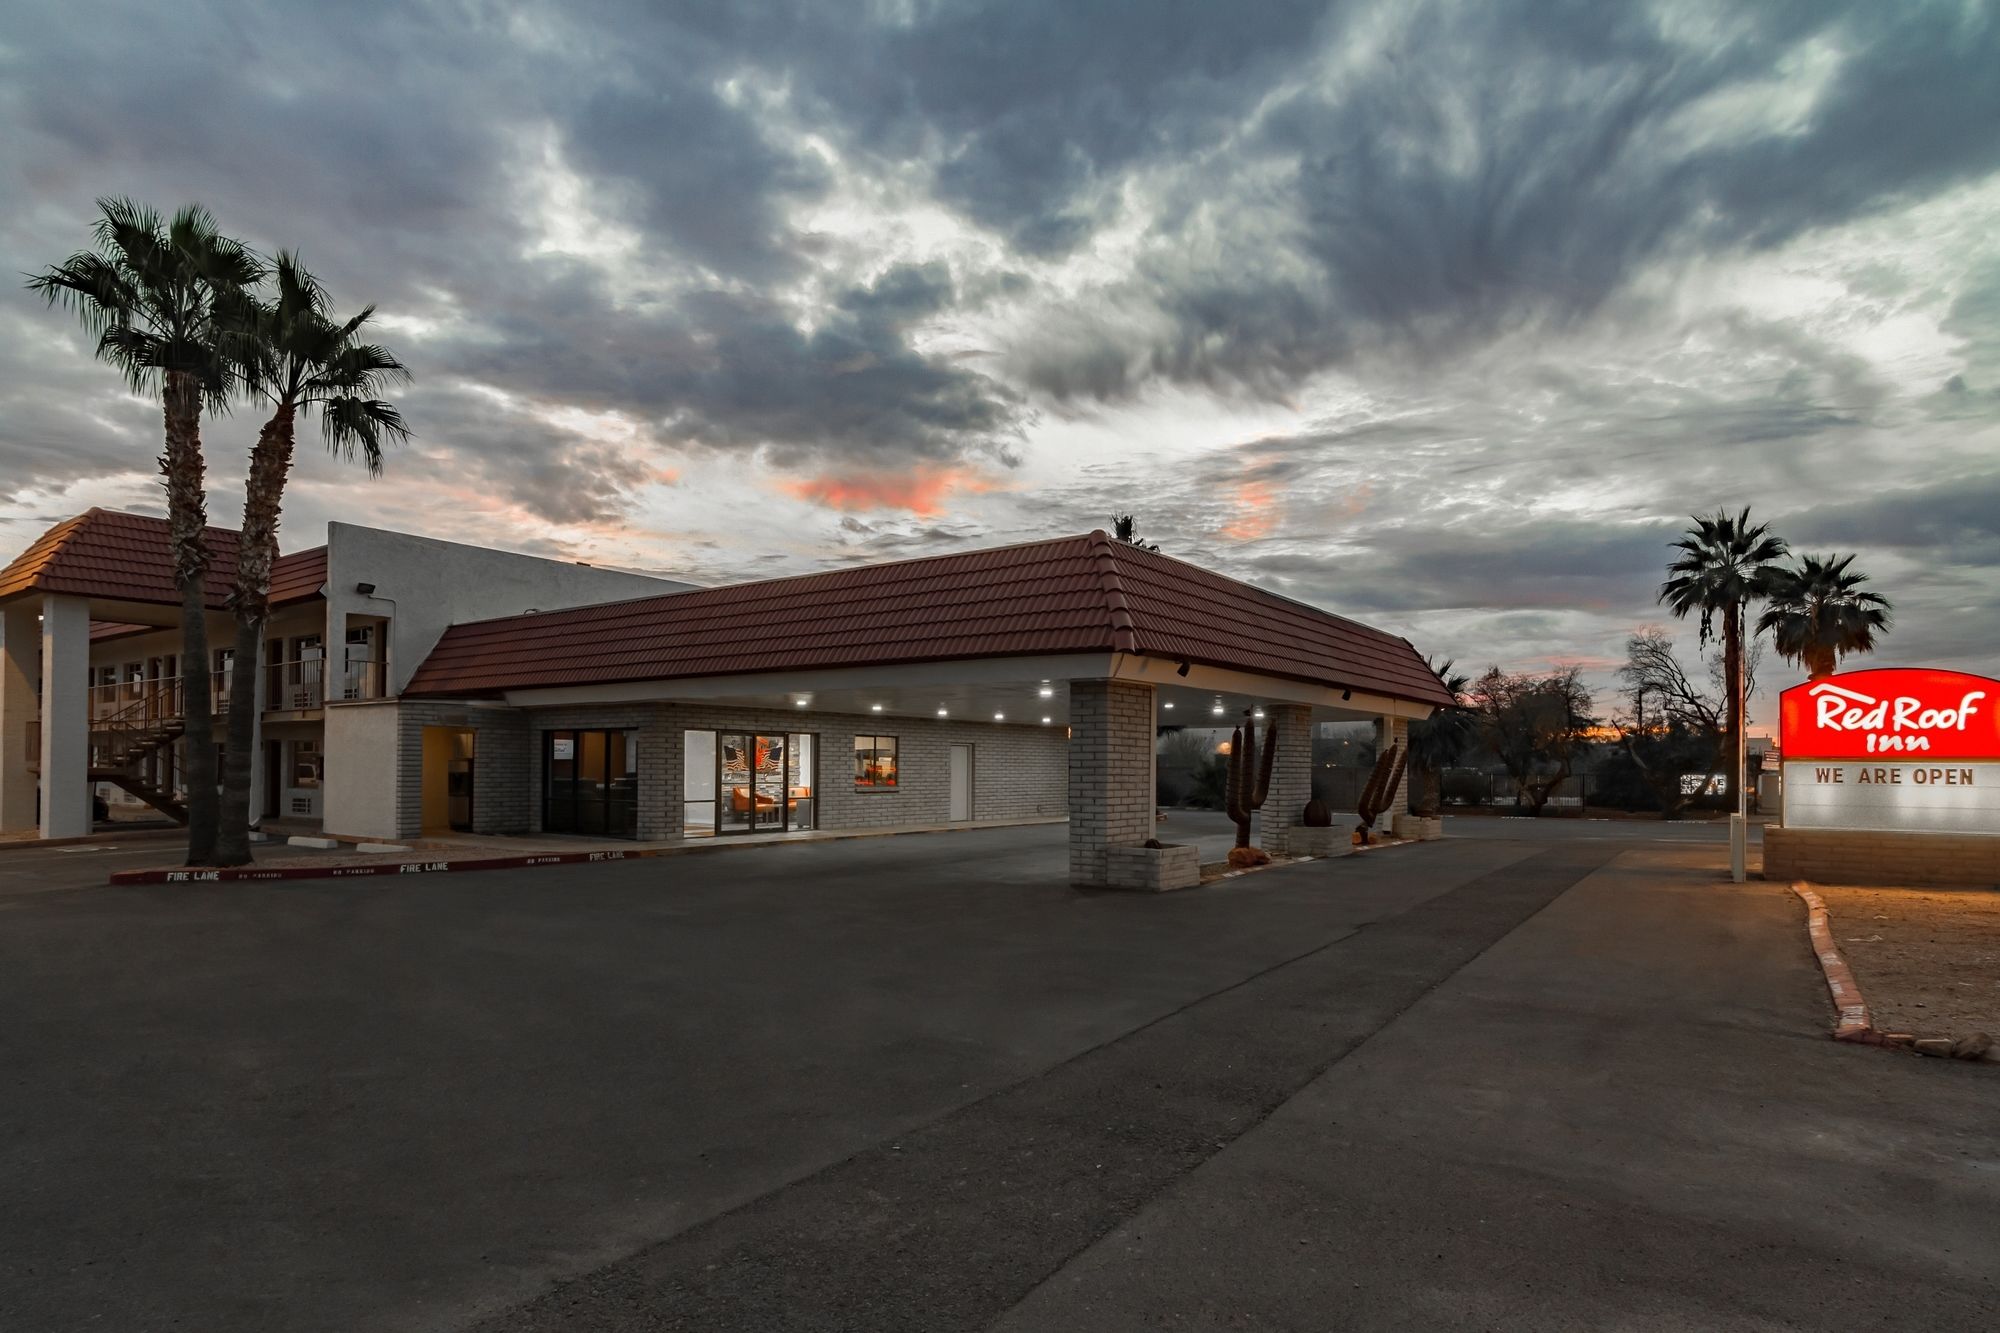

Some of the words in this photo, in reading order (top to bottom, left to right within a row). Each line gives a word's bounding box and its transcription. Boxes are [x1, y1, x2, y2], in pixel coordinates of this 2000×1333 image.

[1816, 694, 1889, 731] Red
[1892, 691, 1986, 731] Roof
[1815, 768, 1844, 783] WE
[1858, 768, 1901, 784] ARE
[1913, 768, 1974, 785] OPEN
[400, 864, 421, 873] FIRE
[425, 862, 448, 872] LANE
[167, 872, 190, 882] FIRE
[194, 871, 220, 881] LANE
